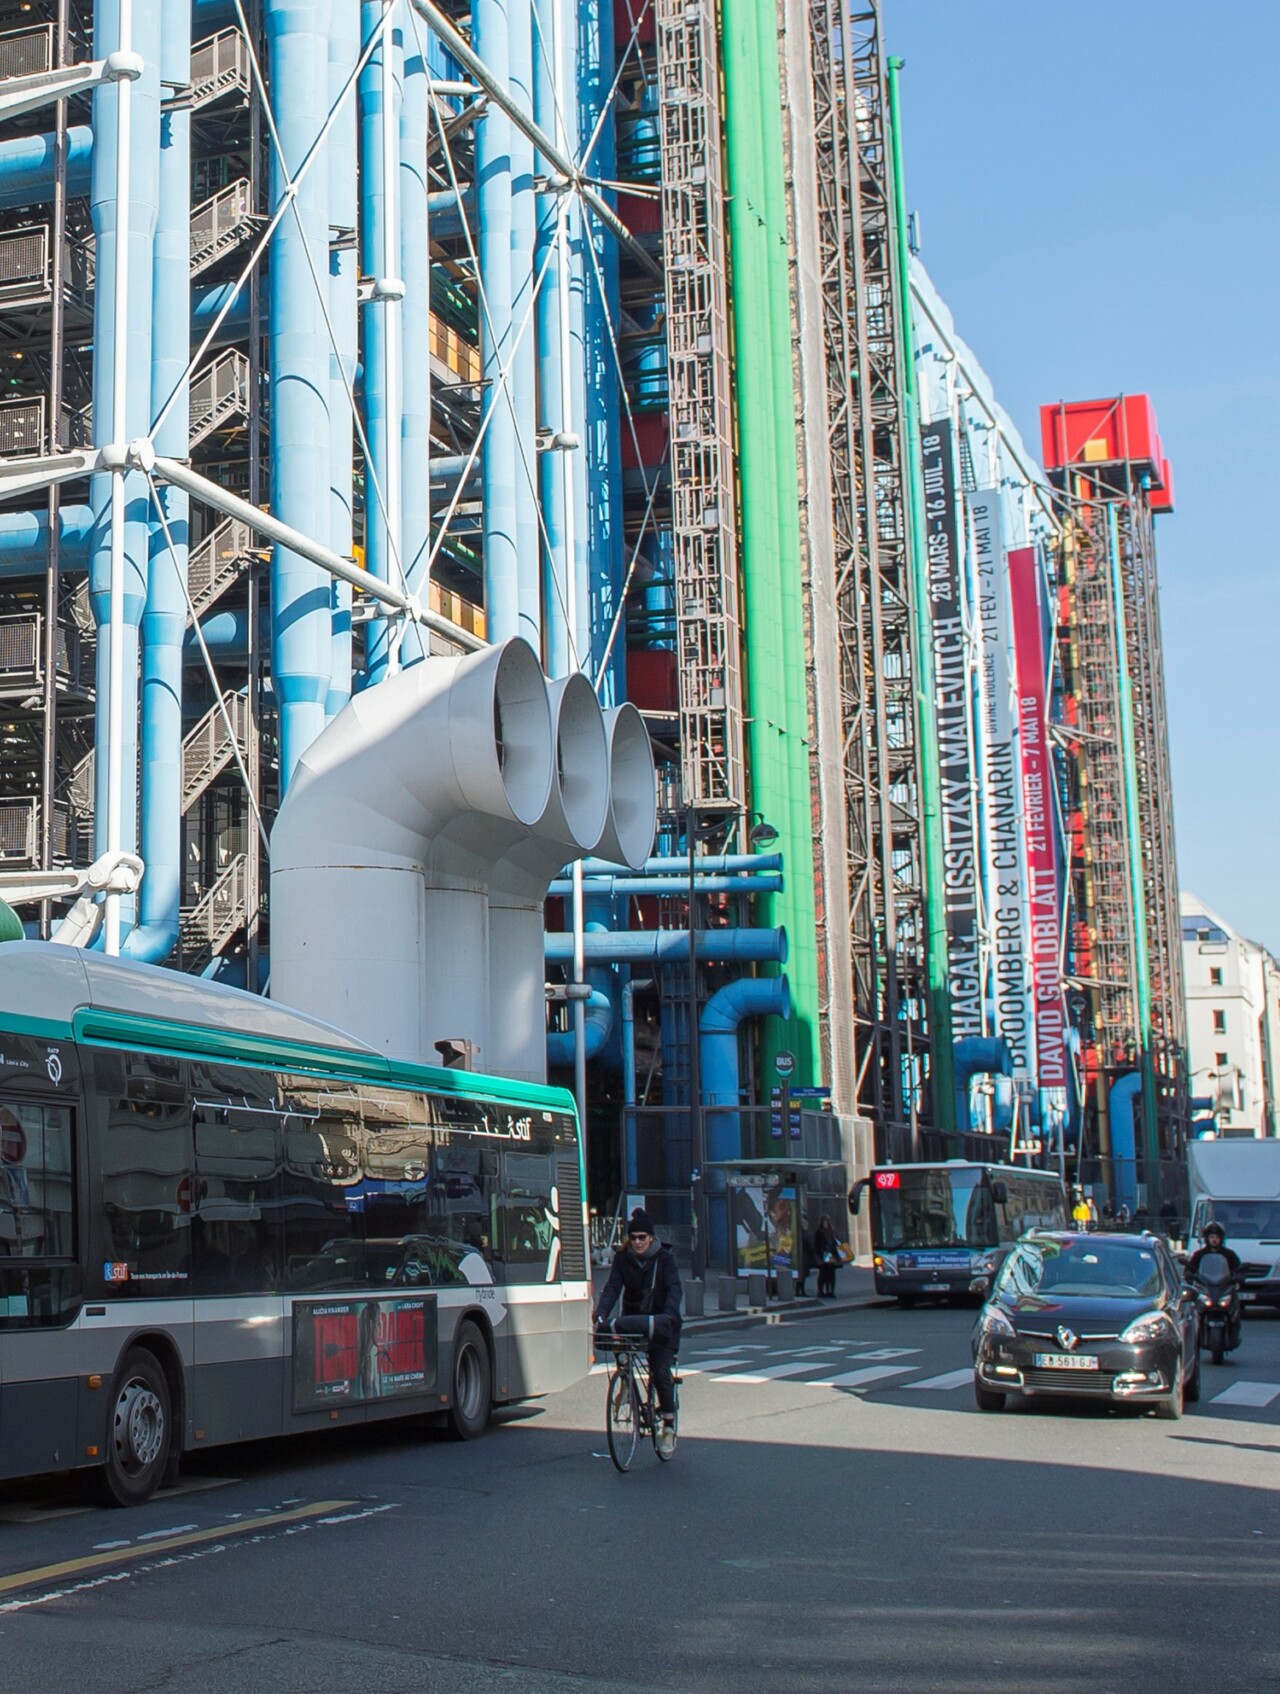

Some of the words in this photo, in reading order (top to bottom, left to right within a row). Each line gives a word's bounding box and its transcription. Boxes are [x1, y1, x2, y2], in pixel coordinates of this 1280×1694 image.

[923, 434, 941, 455] 18
[924, 457, 945, 495] JUIL.
[927, 500, 946, 519] 16
[972, 505, 988, 519] 18
[976, 526, 991, 549] MAI
[928, 532, 951, 580] MARS
[978, 562, 993, 576] 21
[932, 582, 952, 603] 28
[982, 628, 998, 643] 21
[982, 652, 996, 699] VIOLENCE
[1021, 696, 1037, 711] 18
[985, 700, 997, 733] DIVINE
[1022, 715, 1039, 743] MAI
[1023, 748, 1040, 757] 7
[986, 742, 1017, 869] CHANARIN
[1027, 835, 1046, 852] 21
[997, 880, 1019, 896] &
[1029, 867, 1060, 1003] GOLDBLATT
[1038, 1009, 1063, 1080] DAVID
[776, 1056, 792, 1066] BUS
[877, 1173, 895, 1187] 47
[113, 1263, 128, 1279] stif
[476, 1288, 495, 1303] Hybride
[689, 1344, 924, 1360] BUS
